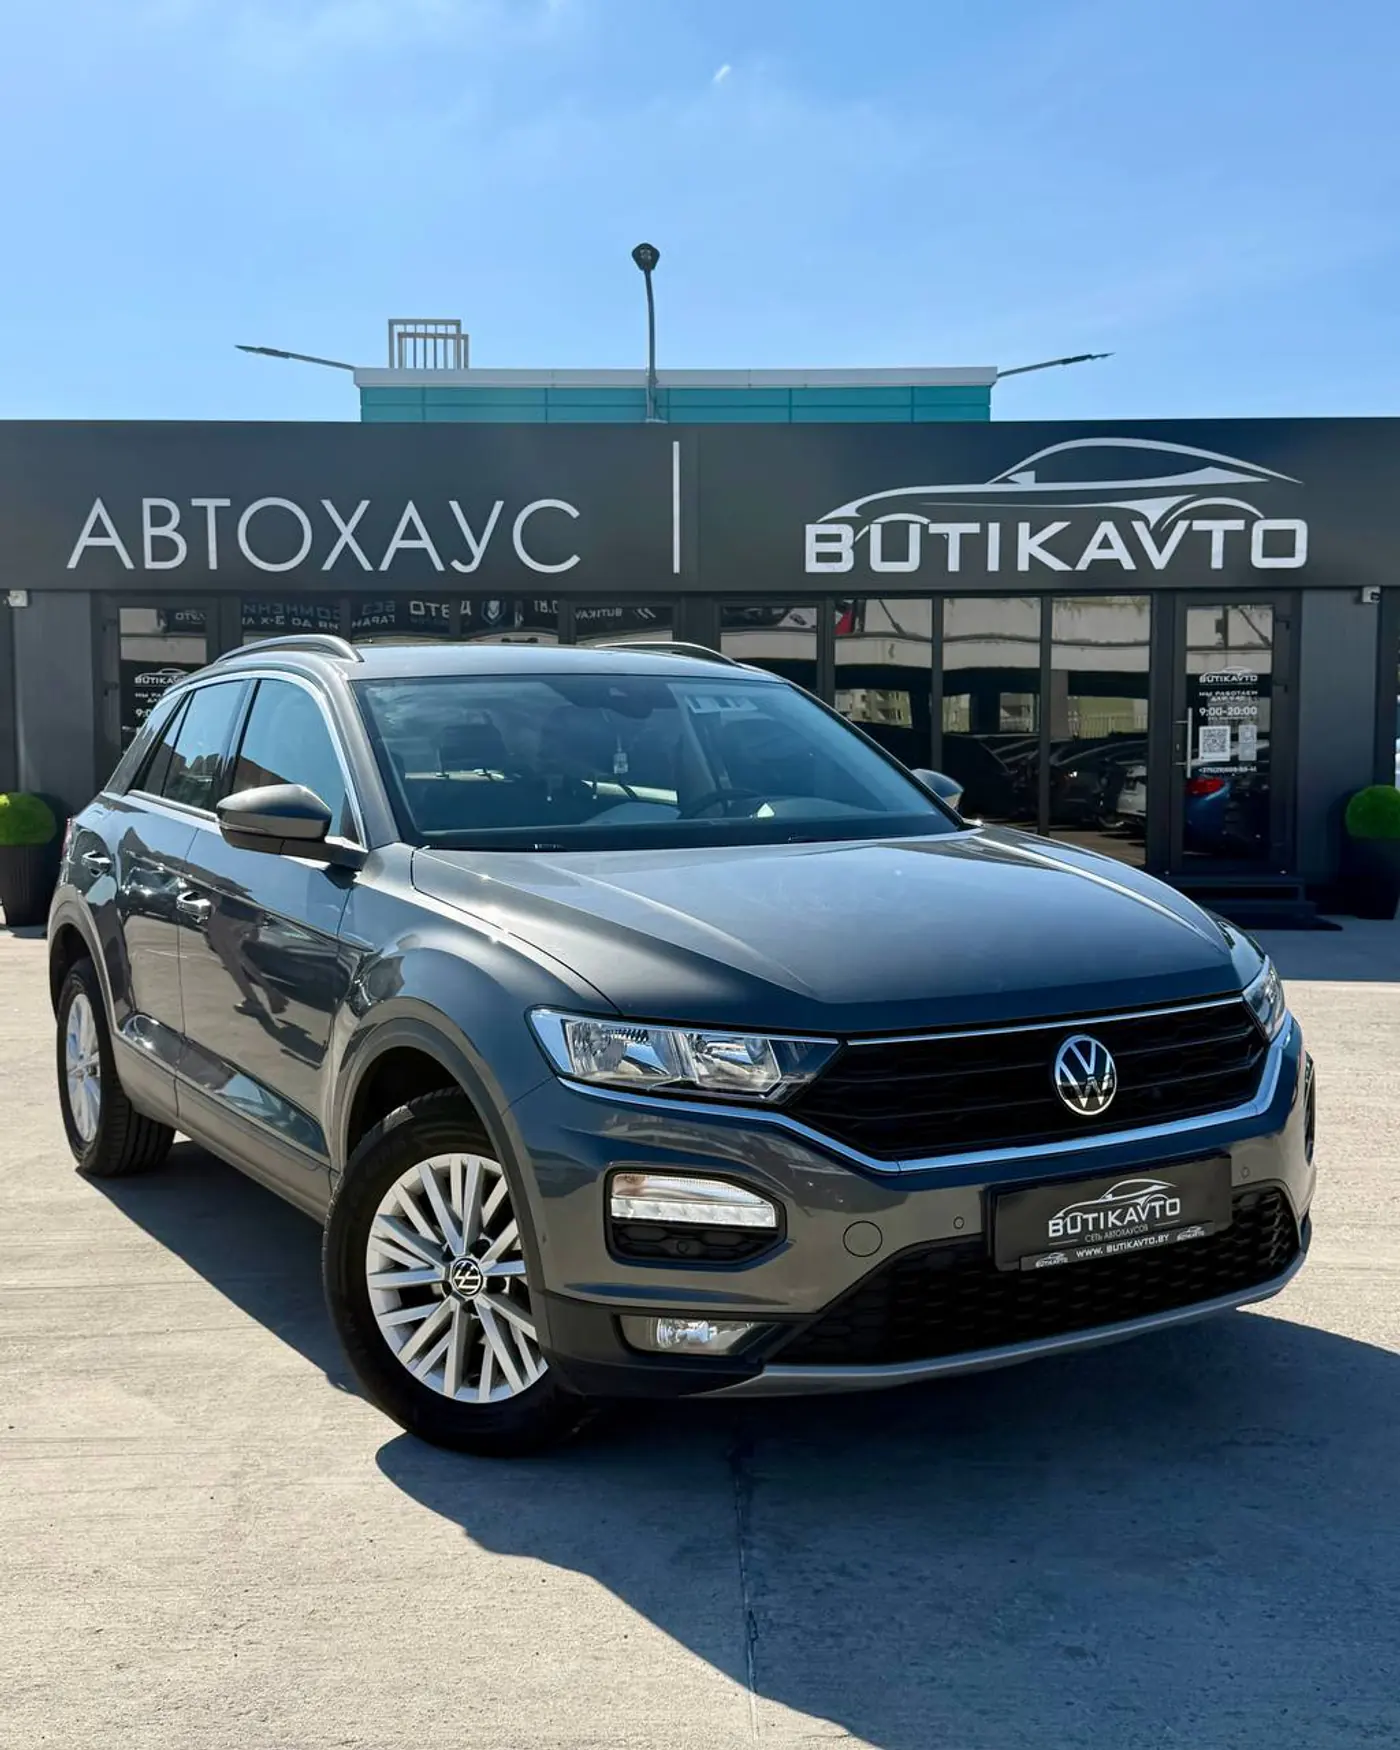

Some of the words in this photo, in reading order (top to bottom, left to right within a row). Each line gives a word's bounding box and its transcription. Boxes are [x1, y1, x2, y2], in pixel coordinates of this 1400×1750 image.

[66, 496, 581, 574] АВТОХАУС
[805, 518, 1308, 573] BUTIKAVTO
[1199, 675, 1258, 683] BUTIKAVTO
[1199, 706, 1258, 716] 9:00-20:00
[1048, 1197, 1181, 1238] BUTIKAVTO
